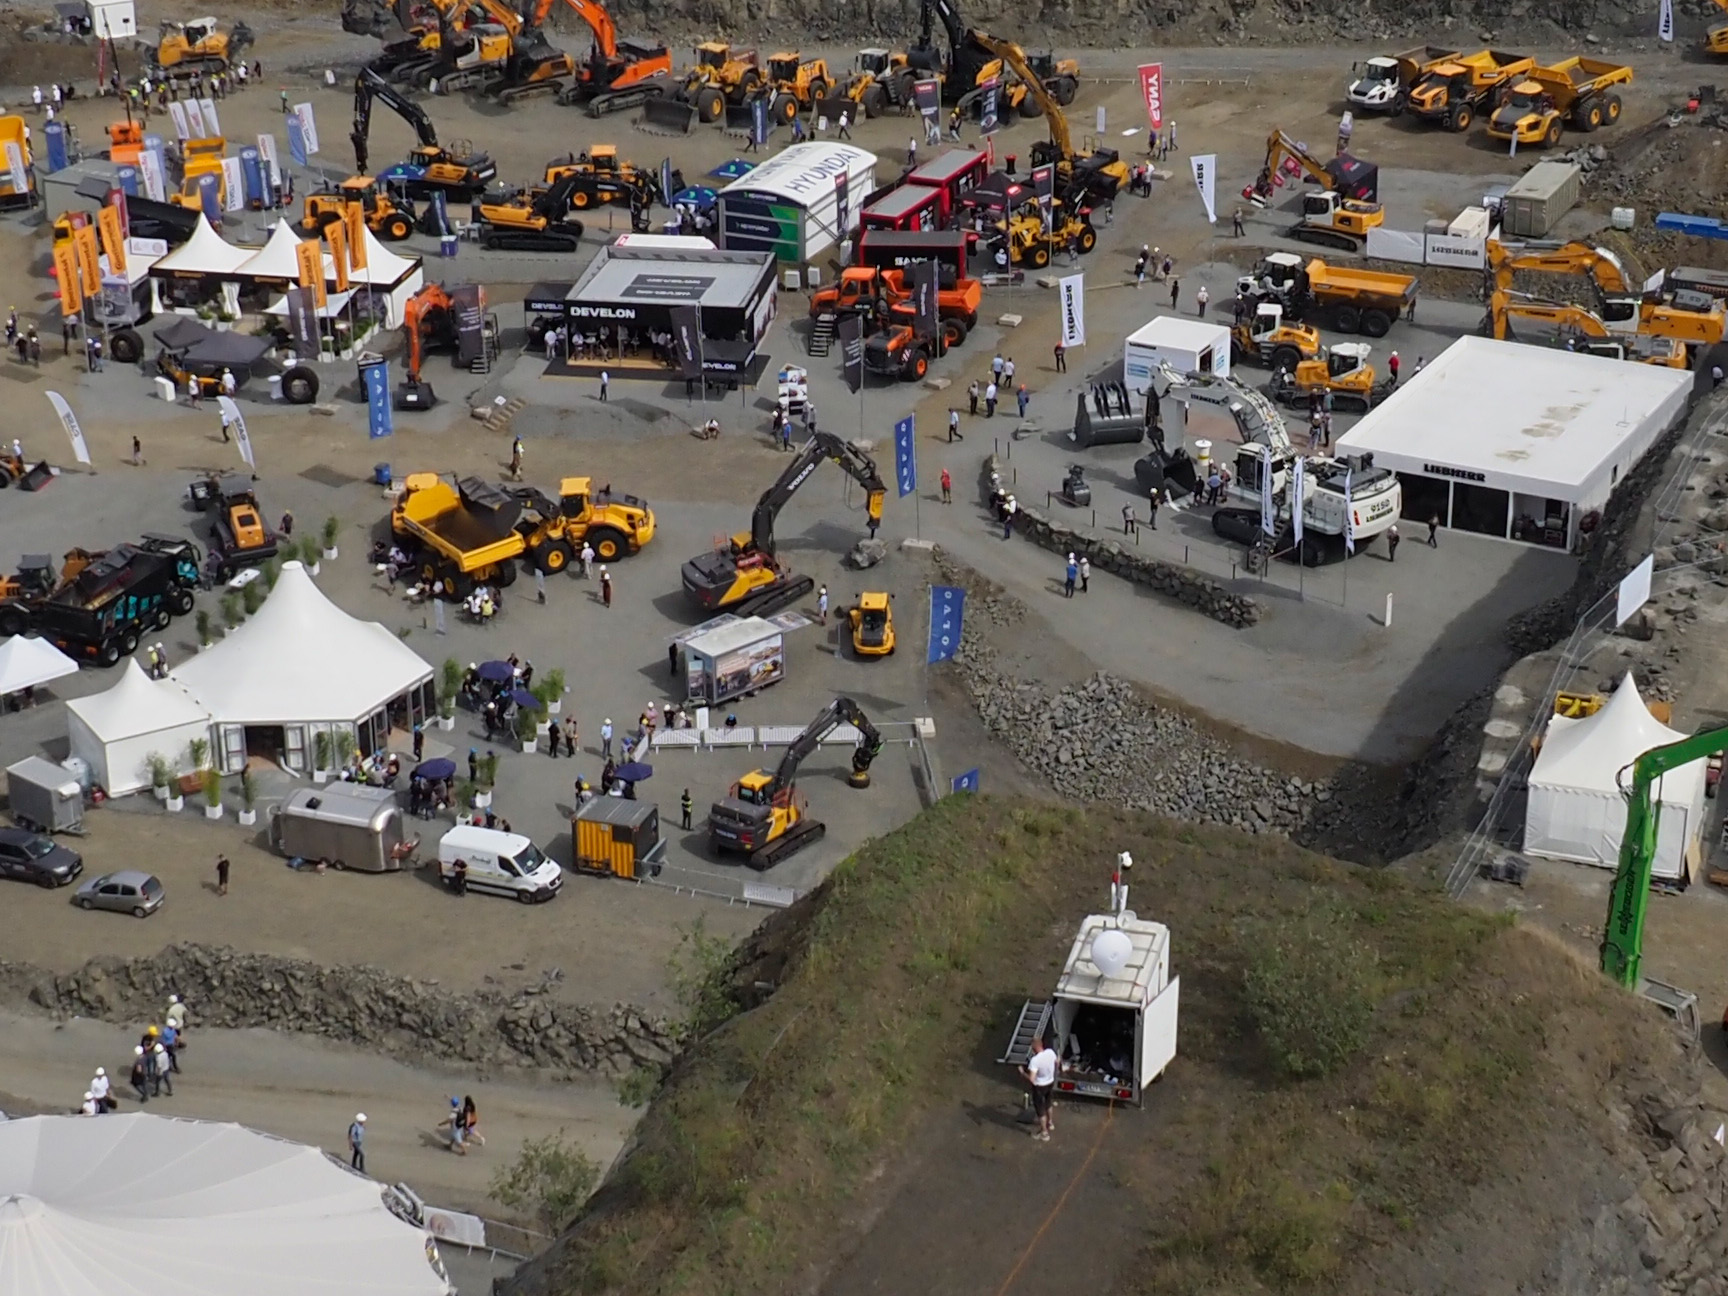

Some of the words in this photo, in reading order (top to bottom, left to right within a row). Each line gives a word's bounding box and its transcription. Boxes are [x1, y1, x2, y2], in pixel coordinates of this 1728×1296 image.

[784, 148, 861, 193] HYUNDAI
[531, 302, 564, 310] DEVELO
[571, 306, 636, 319] DEVELON
[702, 361, 736, 371] EVELON
[786, 463, 815, 490] VOLVO
[1424, 463, 1486, 482] LIEBHERR
[939, 590, 953, 661] VOLVO
